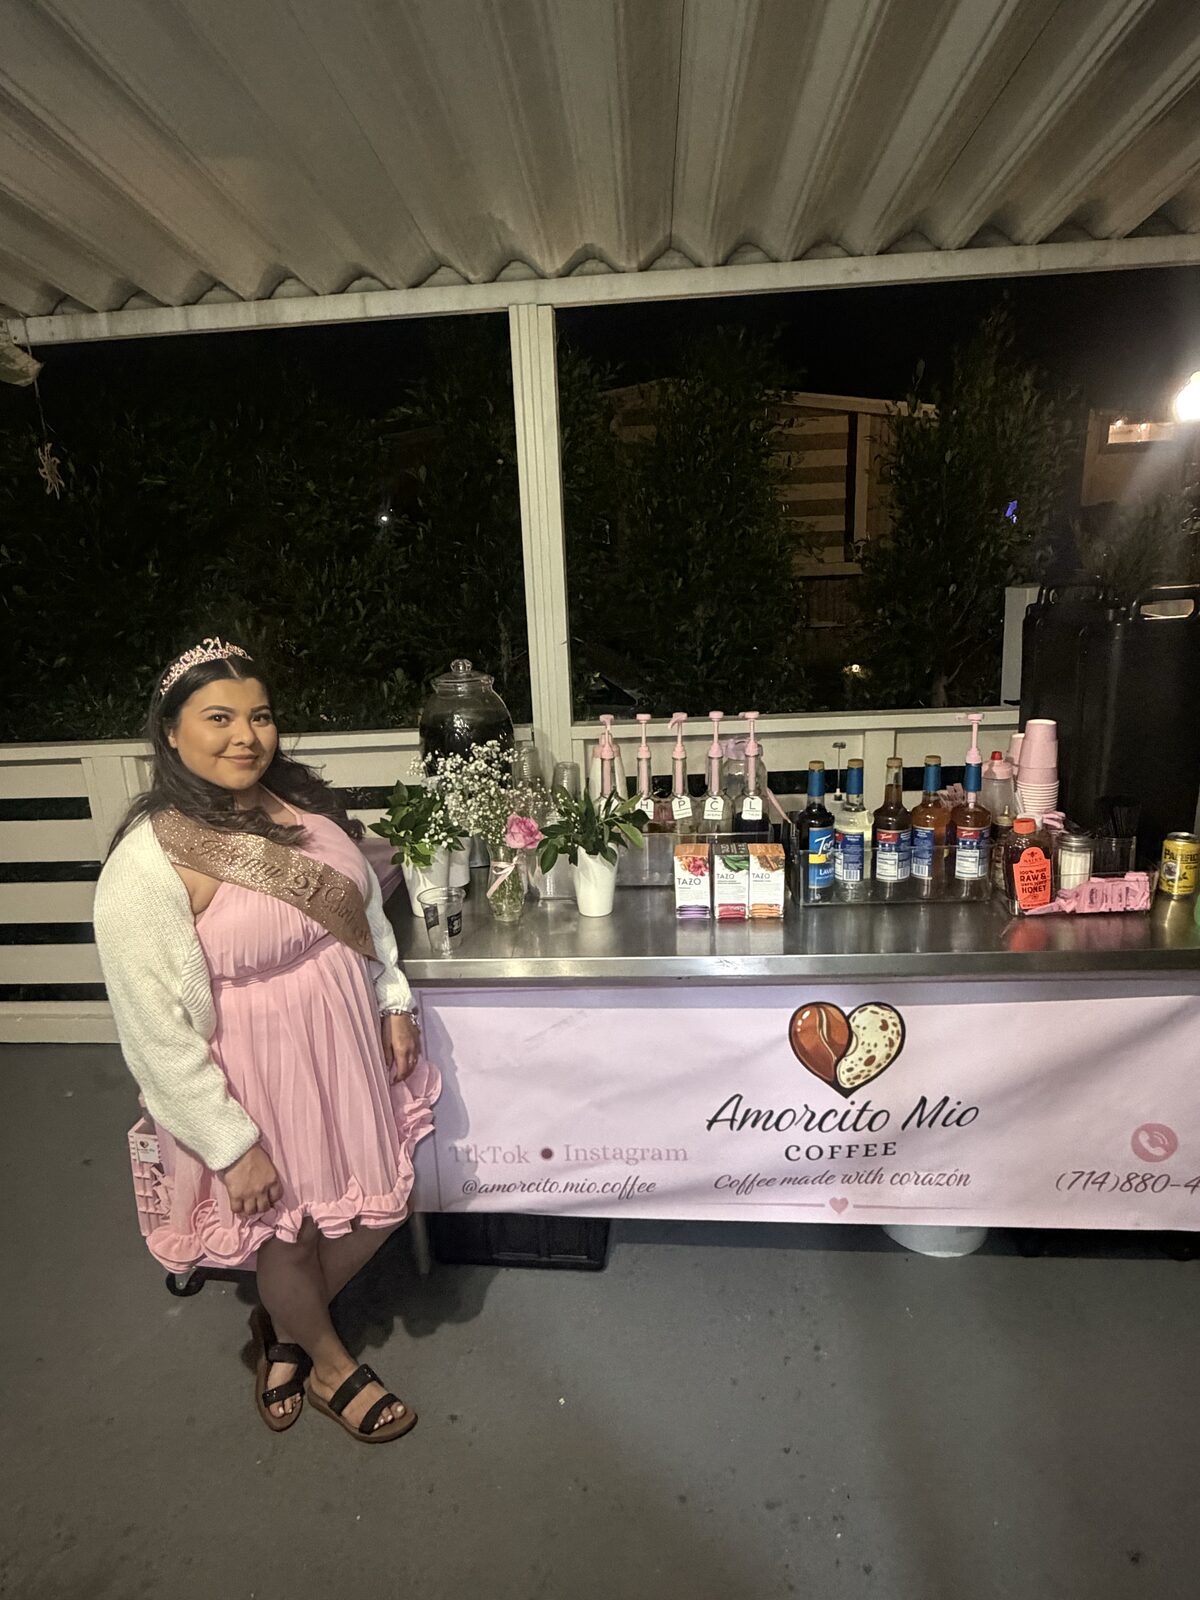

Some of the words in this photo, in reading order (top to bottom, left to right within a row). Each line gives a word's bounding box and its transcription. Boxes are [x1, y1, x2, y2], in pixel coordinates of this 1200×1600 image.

[640, 801, 648, 810] H
[677, 800, 686, 808] P
[710, 801, 719, 810] C
[749, 801, 756, 810] L
[242, 858, 284, 884] my
[677, 877, 702, 886] TAZO
[1020, 874, 1039, 882] RAW
[1022, 885, 1046, 894] HONEY
[705, 1093, 891, 1133] Amorcito
[901, 1095, 980, 1131] Mio
[449, 1143, 531, 1164] TikTok
[563, 1143, 689, 1166] Instagram
[784, 1141, 897, 1162] COFFEE
[713, 1172, 779, 1196] Coffee
[781, 1169, 837, 1186] made
[840, 1166, 884, 1187] with
[889, 1168, 972, 1188] corazón
[462, 1175, 657, 1200] @amorcito.mio.coffee
